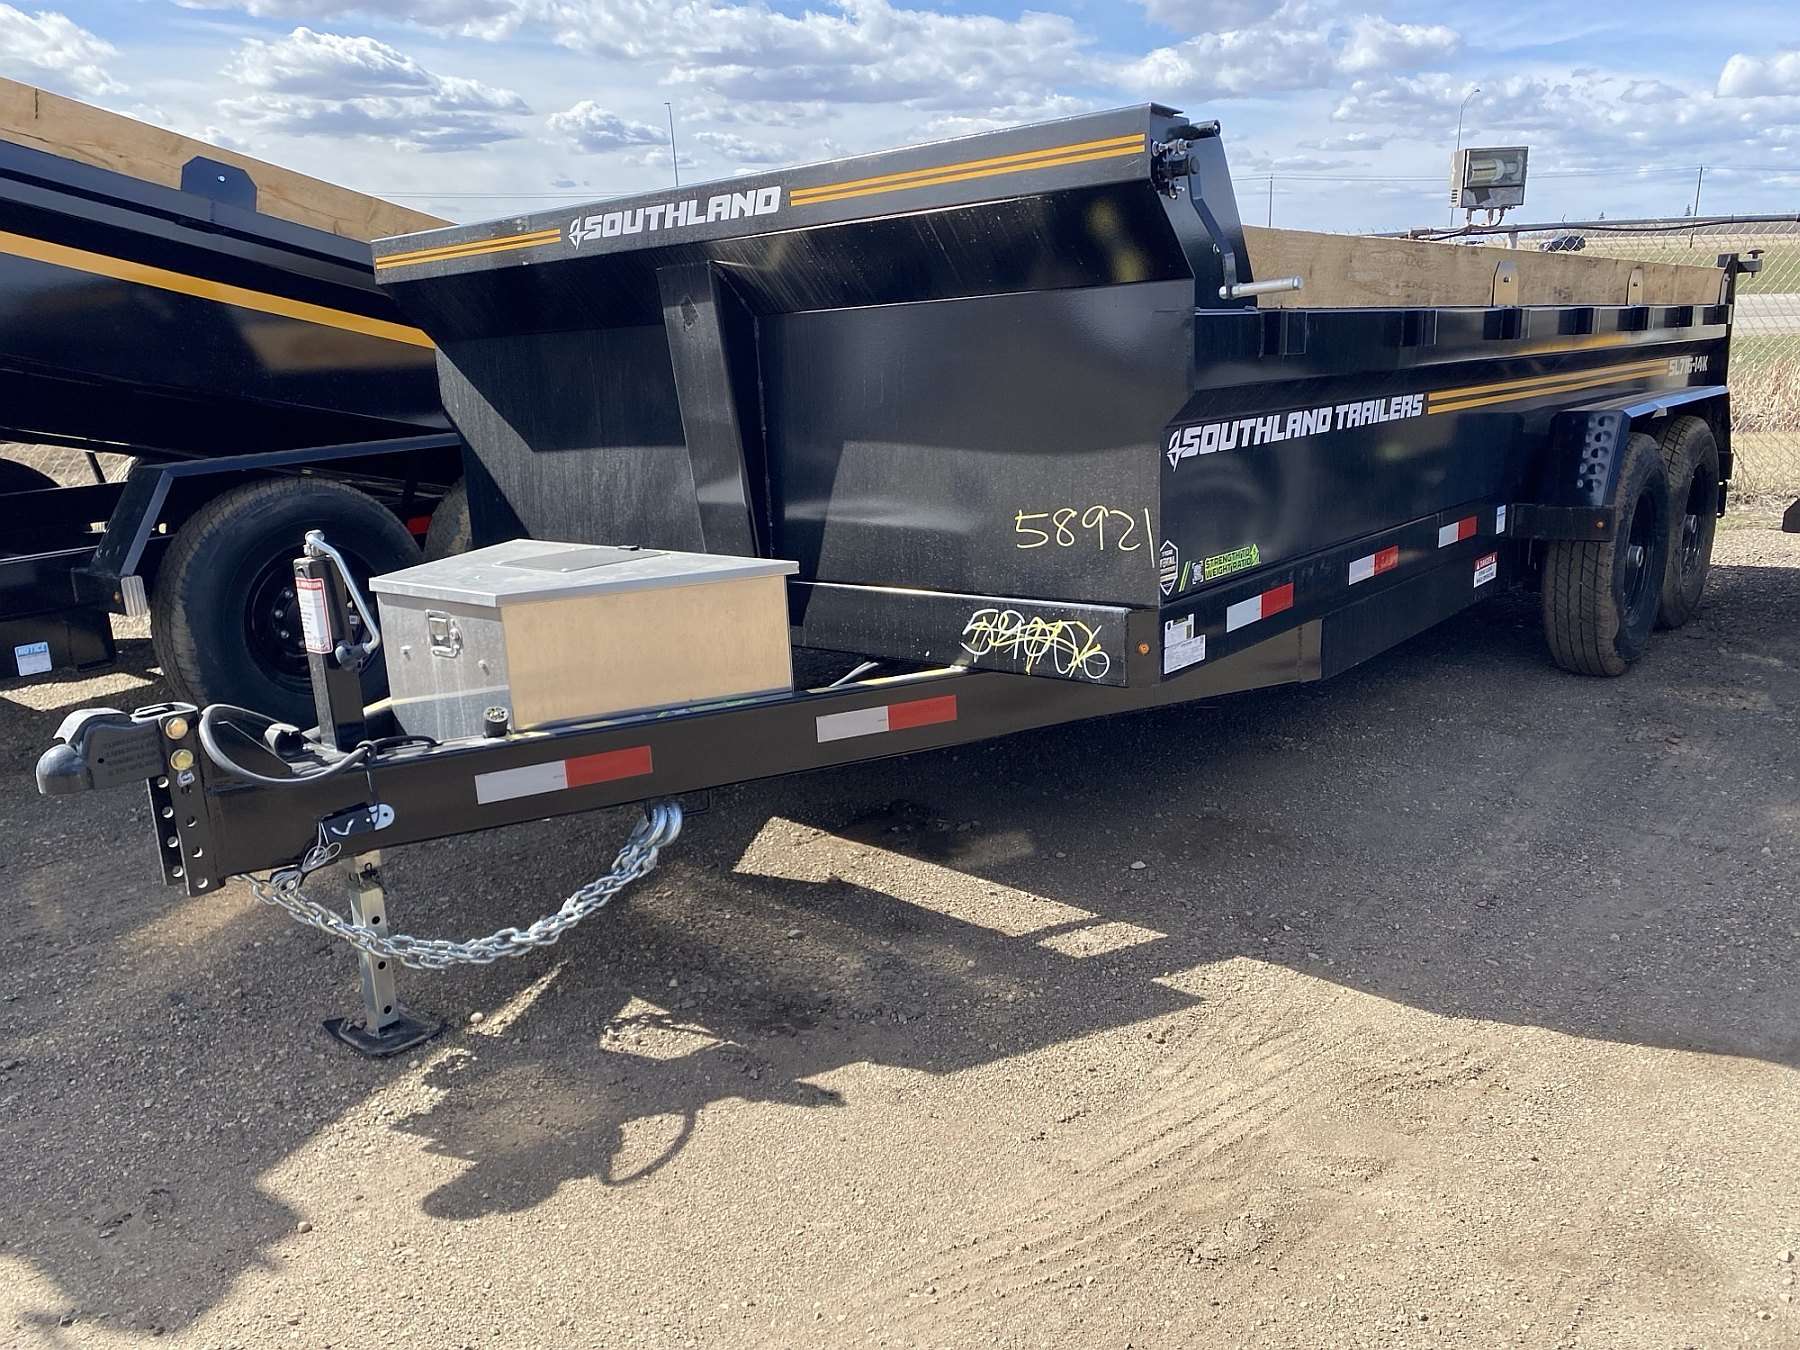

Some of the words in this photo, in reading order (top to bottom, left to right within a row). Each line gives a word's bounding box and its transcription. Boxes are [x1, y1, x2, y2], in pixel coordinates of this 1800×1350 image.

[584, 186, 781, 241] SOUTHLAND
[1181, 407, 1333, 459] SOUTHLAND
[1335, 393, 1425, 431] TRAILERS
[1014, 505, 1155, 569] 58921
[1205, 551, 1241, 569] STRENGTH
[1205, 563, 1231, 579] WEIGHT
[1232, 557, 1252, 572] RATIO
